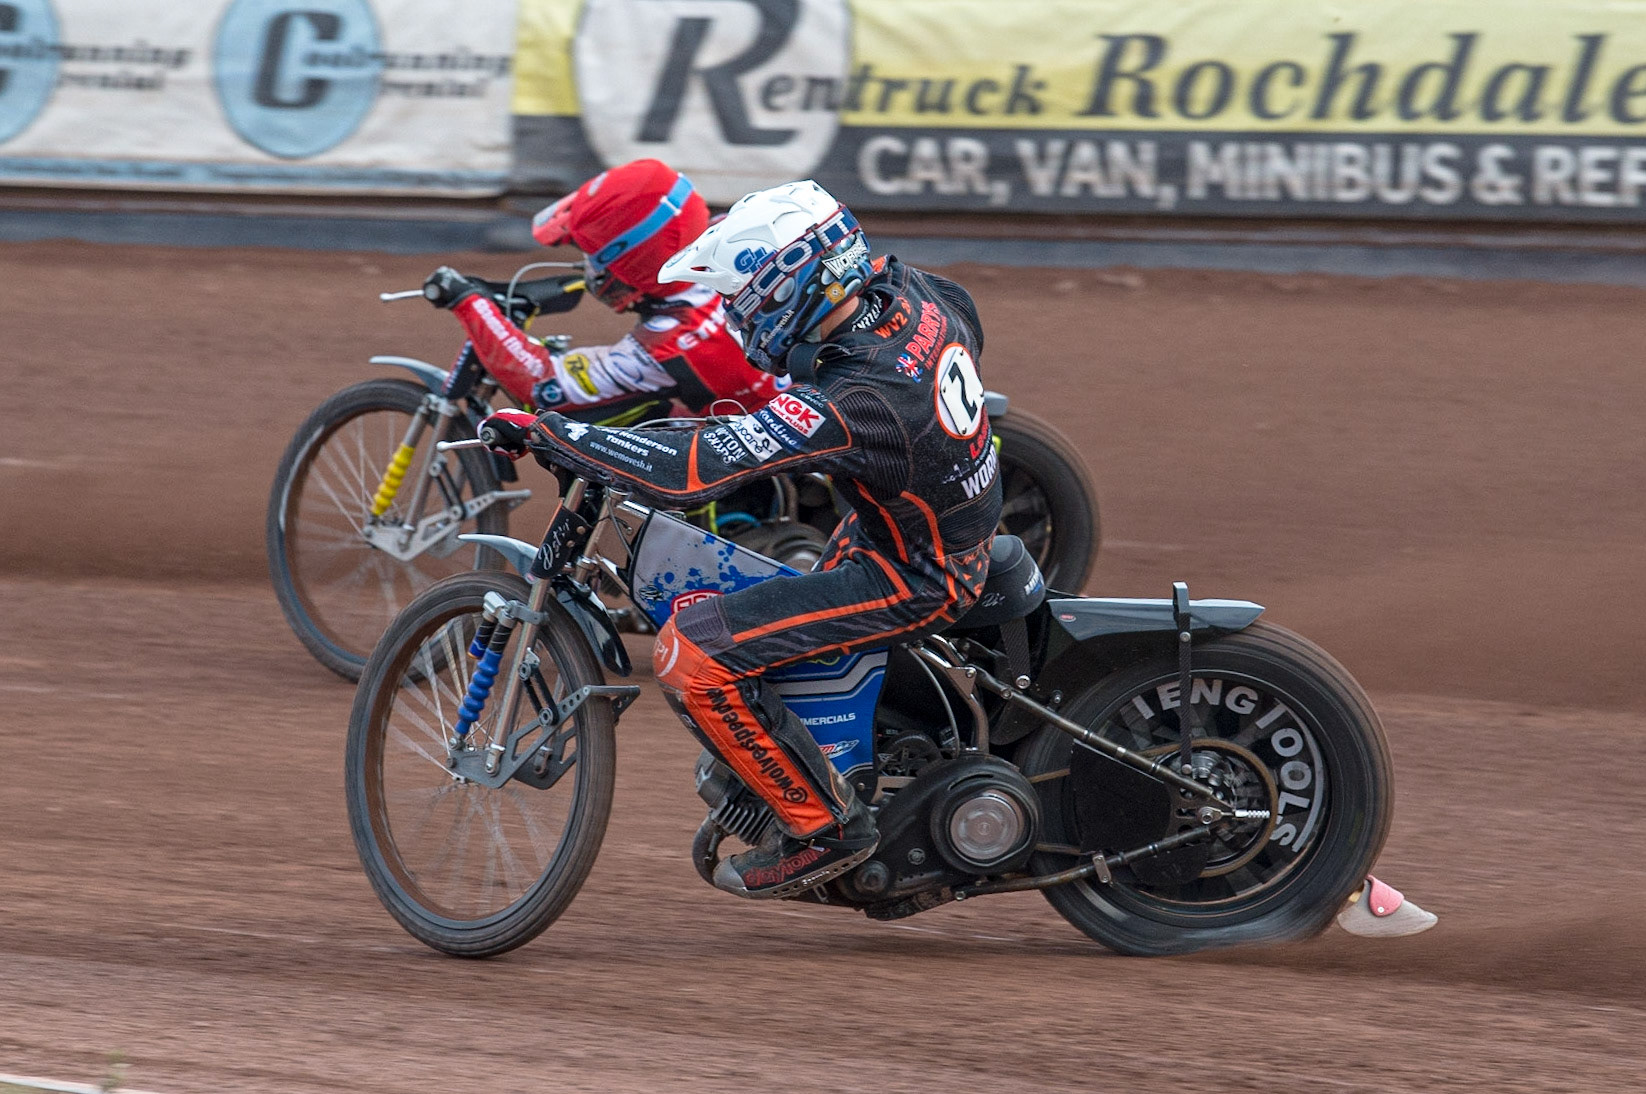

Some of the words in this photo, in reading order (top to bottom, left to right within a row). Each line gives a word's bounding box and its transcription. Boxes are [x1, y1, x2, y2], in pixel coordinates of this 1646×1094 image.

[857, 136, 1009, 204] CAR,
[1014, 139, 1175, 210] VAN,
[1185, 141, 1464, 204] MINIBUS
[1470, 143, 1525, 205] &
[772, 396, 820, 428] NGK
[948, 361, 978, 422] 2
[605, 434, 650, 457] Tankers
